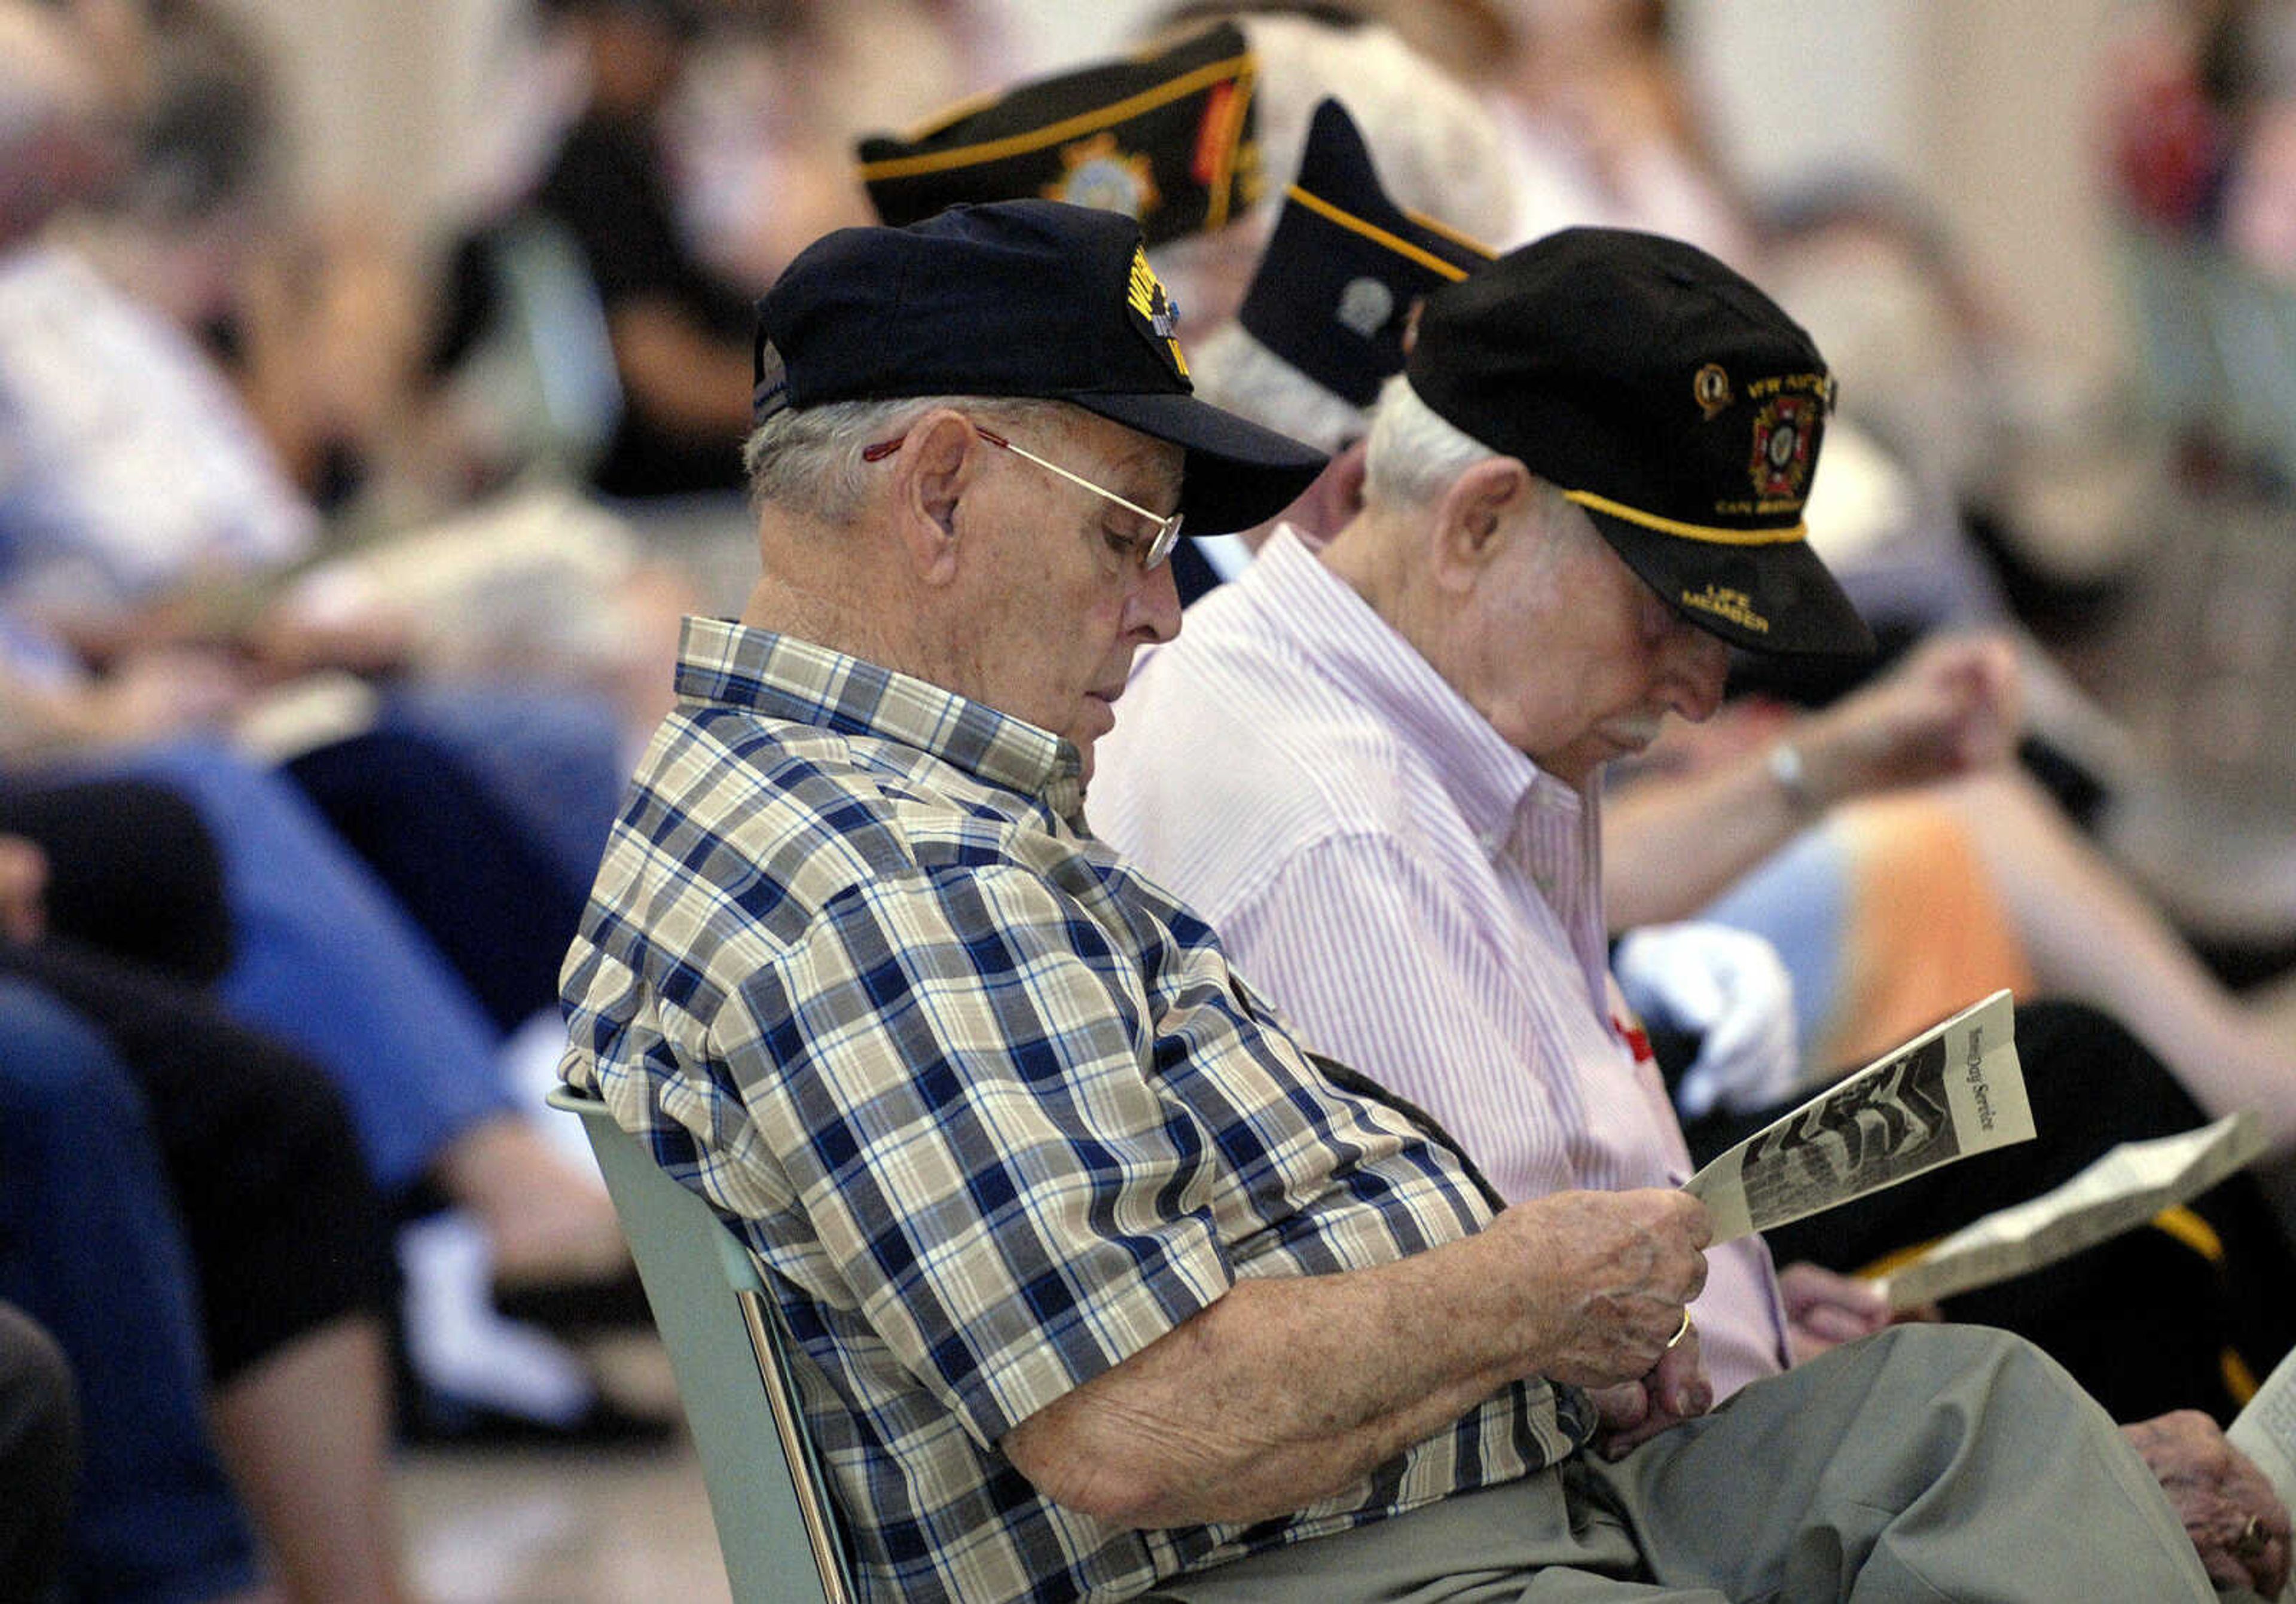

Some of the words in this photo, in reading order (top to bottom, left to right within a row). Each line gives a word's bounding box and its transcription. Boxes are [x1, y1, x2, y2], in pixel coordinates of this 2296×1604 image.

[1682, 589, 1769, 634] MEMBER
[1706, 584, 1750, 607] LIFE
[1967, 1053, 1982, 1083] Day
[1973, 1083, 1996, 1131] Service
